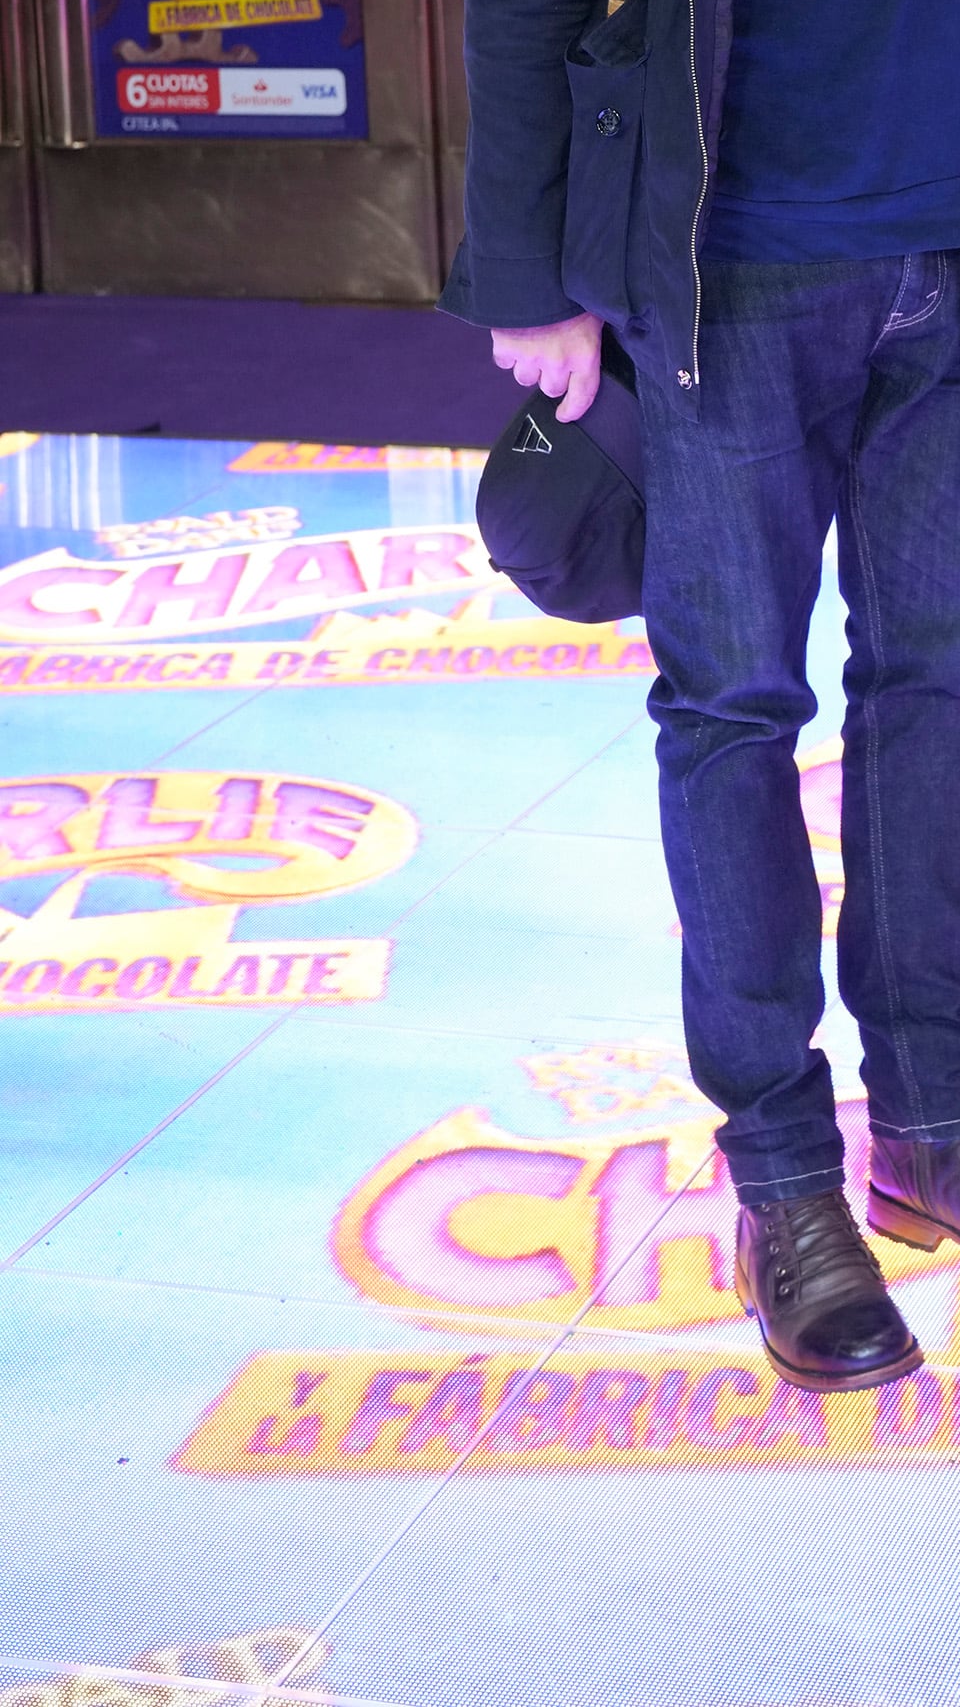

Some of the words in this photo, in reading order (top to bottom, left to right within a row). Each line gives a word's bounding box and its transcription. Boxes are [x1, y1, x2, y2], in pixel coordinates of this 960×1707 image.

[126, 73, 149, 109] 6
[146, 73, 209, 93] CUOTAS
[232, 94, 293, 107] Santander
[301, 84, 338, 99] VISA
[0, 531, 476, 631] CHAR
[256, 649, 349, 680] DE
[365, 641, 656, 677] CHOCOLA
[0, 952, 350, 998] OCOLATE
[248, 1413, 322, 1456] LA
[337, 1354, 830, 1456] FÁBRICA
